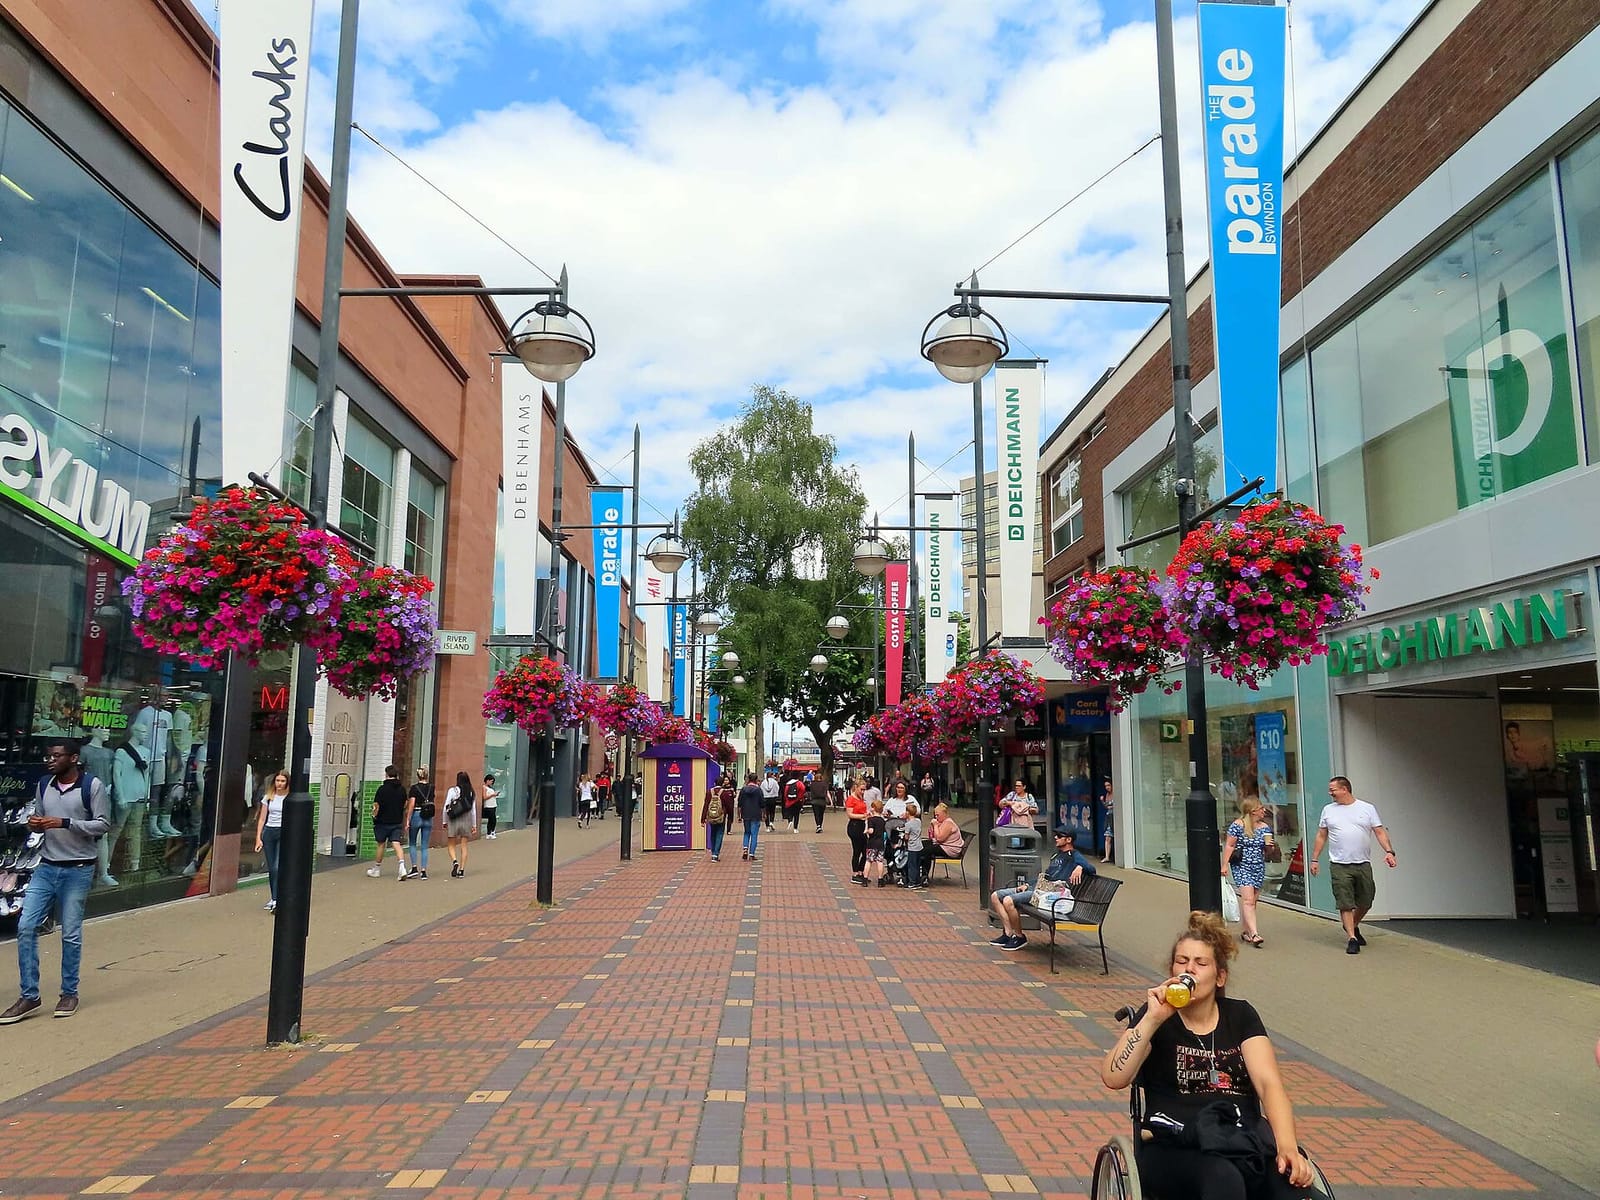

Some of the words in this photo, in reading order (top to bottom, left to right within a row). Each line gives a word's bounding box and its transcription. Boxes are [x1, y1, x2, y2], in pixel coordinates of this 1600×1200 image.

[1209, 96, 1220, 121] THE
[234, 38, 297, 221] Clarks
[1208, 48, 1277, 255] parade
[1263, 183, 1277, 243] SWINDON
[514, 393, 531, 519] DEBENHAMS
[1005, 388, 1024, 518] DEICHMANN
[601, 507, 620, 586] parade
[929, 513, 941, 602] DEICHMANN
[891, 581, 899, 615] COFFEE
[443, 643, 470, 651] ISLAND
[890, 617, 899, 648] COSTA
[1327, 589, 1570, 677] DEICHMANN
[83, 696, 123, 712] MAKE
[1070, 709, 1105, 717] Factory
[82, 712, 128, 728] WAVES
[1260, 728, 1280, 750] £10
[663, 794, 685, 803] CASH
[666, 785, 683, 793] GET
[663, 803, 685, 812] HERE
